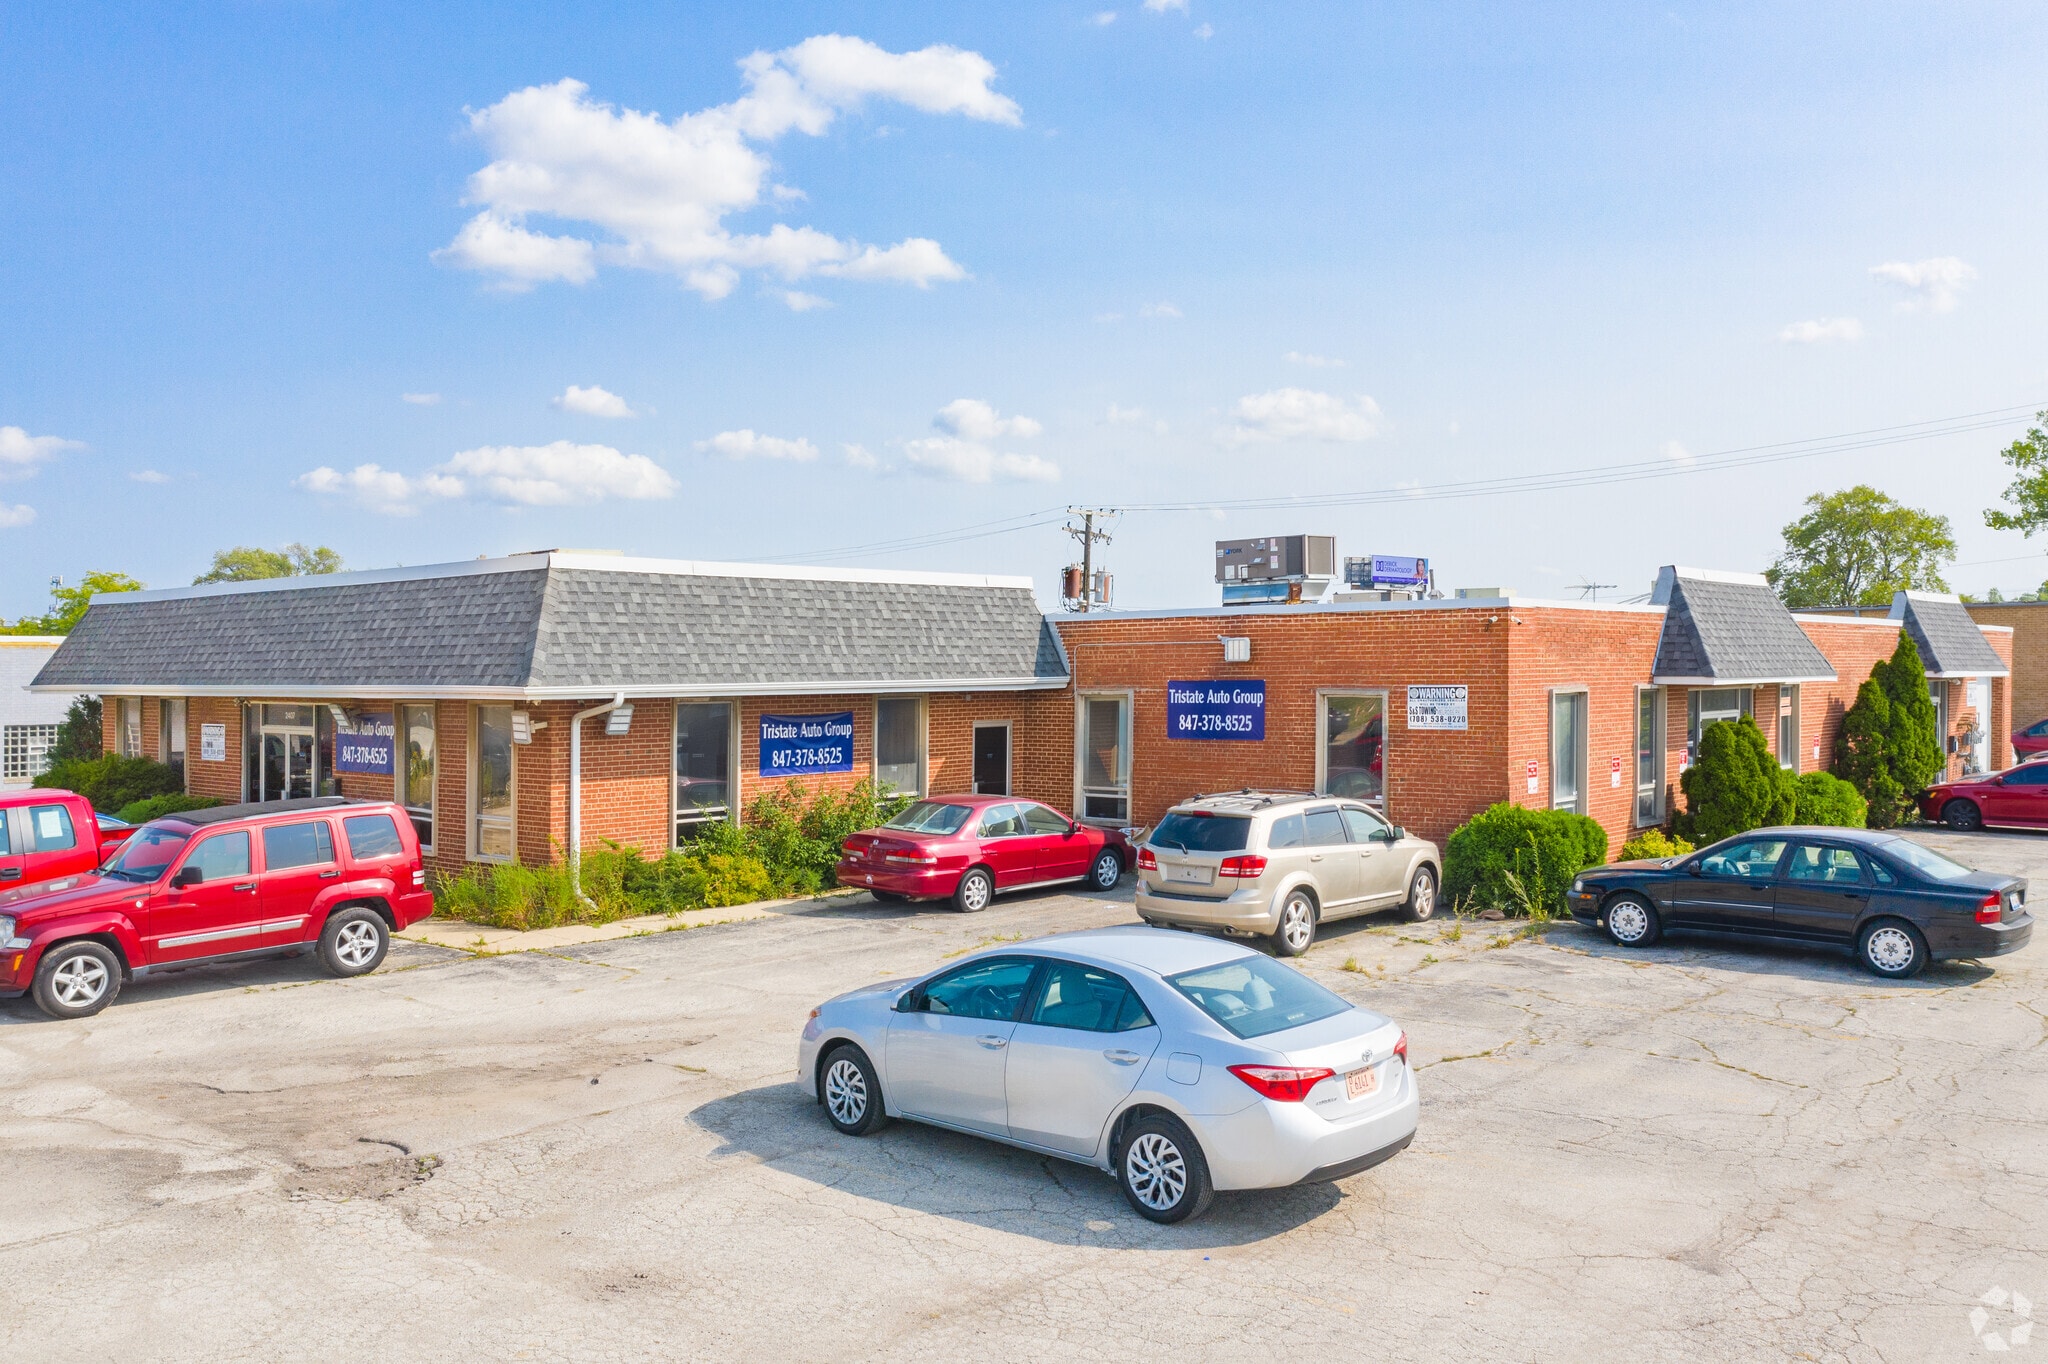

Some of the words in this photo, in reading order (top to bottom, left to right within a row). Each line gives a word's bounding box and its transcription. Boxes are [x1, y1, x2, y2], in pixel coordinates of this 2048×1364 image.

[1169, 689, 1204, 704] Tristate
[1207, 689, 1230, 704] Auto
[1233, 689, 1264, 707] Group
[1418, 687, 1456, 699] WARNING
[1409, 715, 1428, 723] (708)
[1430, 715, 1466, 723] 538-0220
[1419, 706, 1437, 715] TOWING
[359, 721, 374, 736] Auto
[375, 721, 395, 740] Group
[762, 723, 797, 739] Tristate
[800, 722, 822, 738] Auto
[824, 721, 852, 739] Group
[1179, 714, 1252, 731] 847-378-8525
[342, 745, 388, 765] 847-378-8525
[772, 747, 843, 767] 847-378-8525
